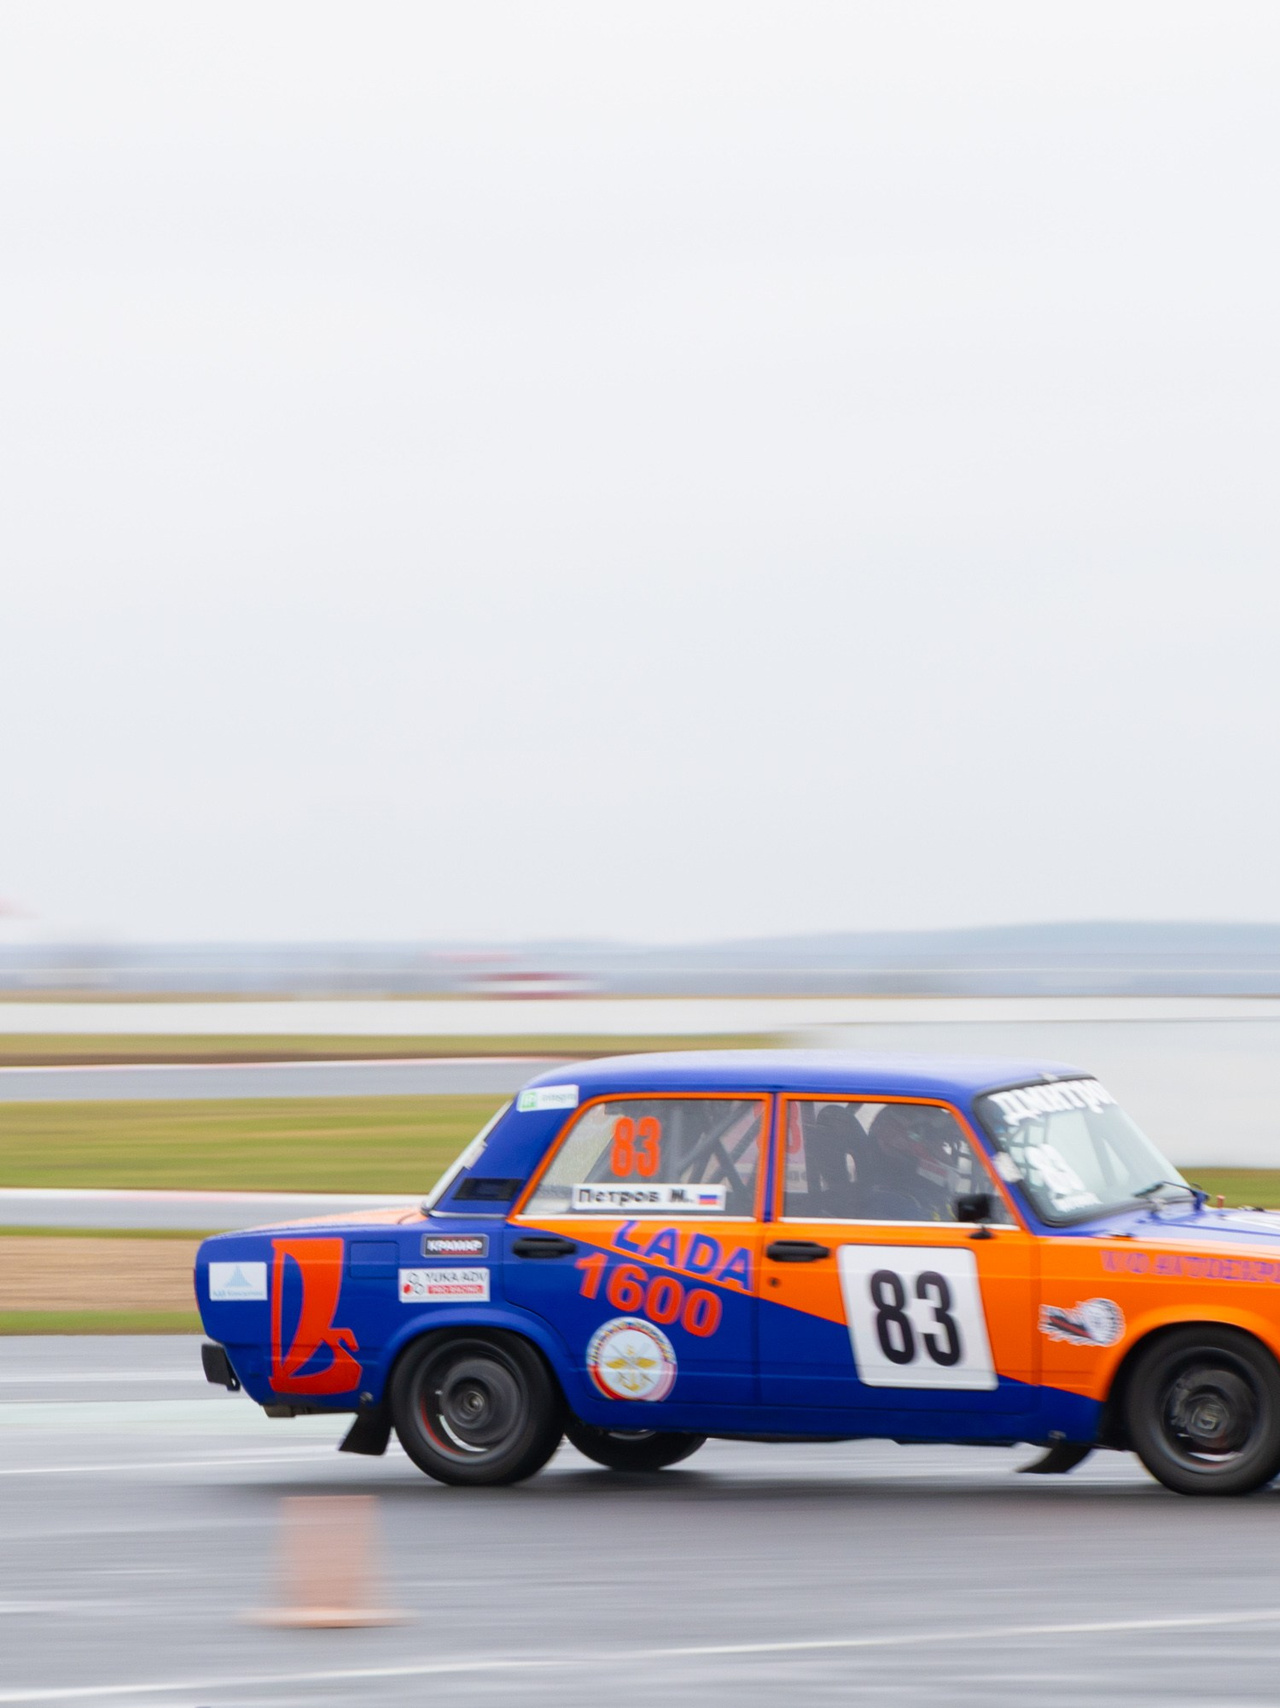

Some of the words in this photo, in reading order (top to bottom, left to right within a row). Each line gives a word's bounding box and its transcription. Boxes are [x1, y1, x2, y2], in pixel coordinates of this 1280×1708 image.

[610, 1116, 662, 1177] 83
[578, 1188, 660, 1206] Петров
[611, 1219, 754, 1293] LADA
[574, 1251, 723, 1338] 1600
[870, 1269, 962, 1367] 83
